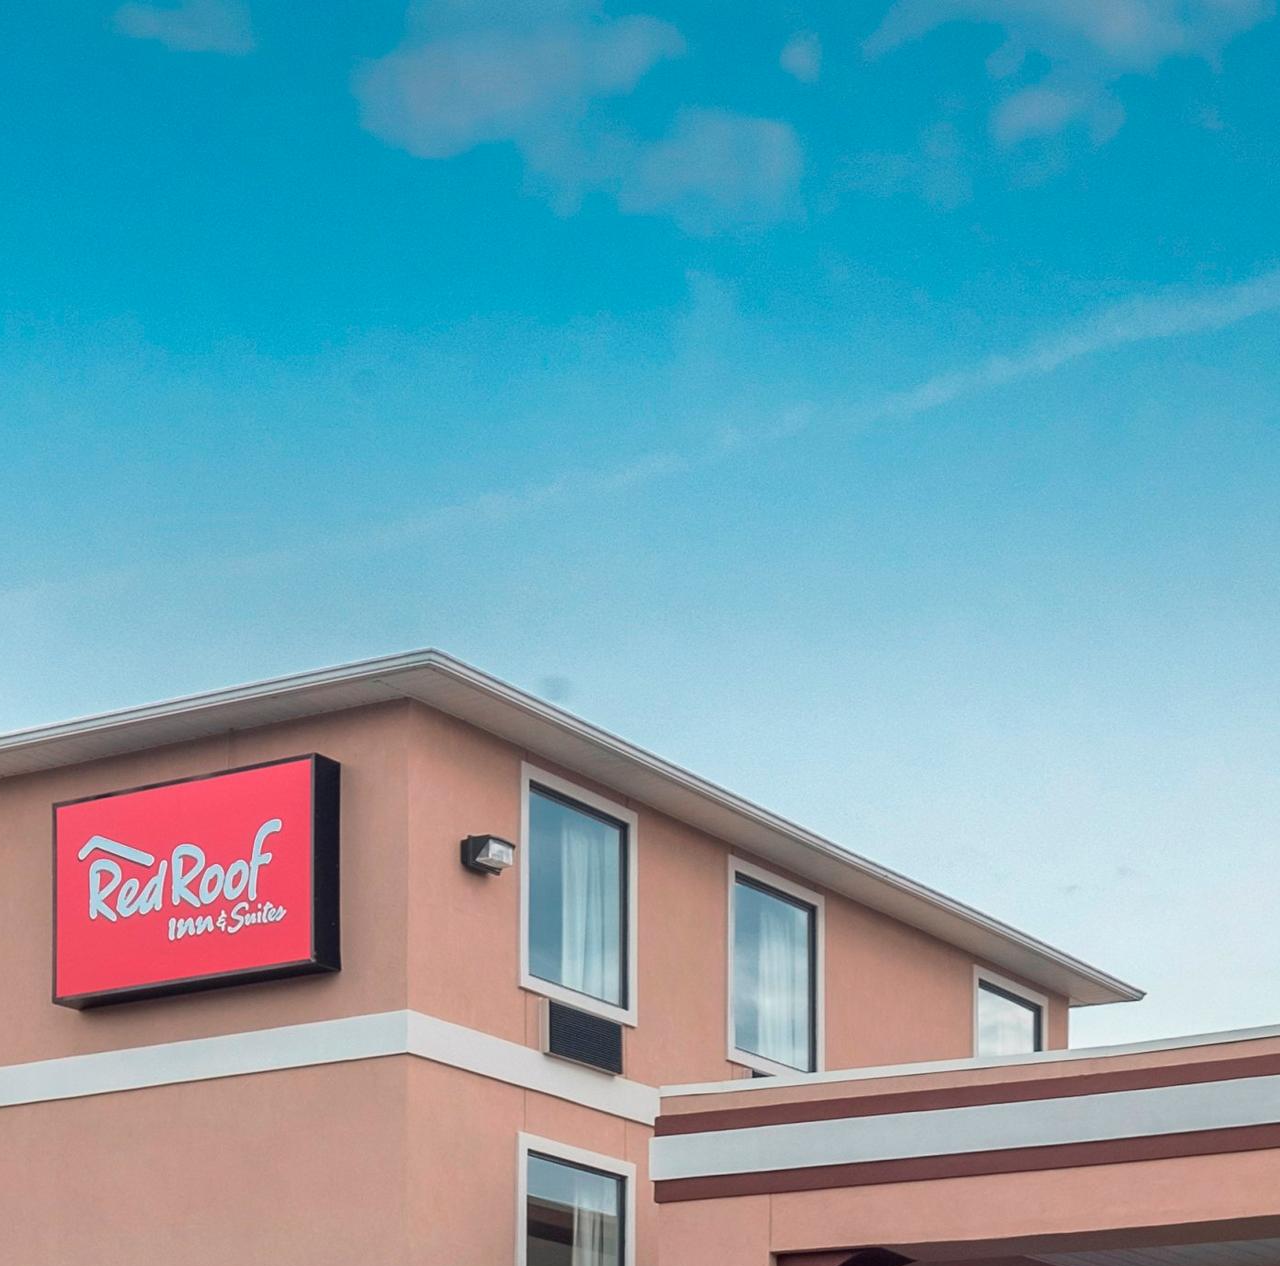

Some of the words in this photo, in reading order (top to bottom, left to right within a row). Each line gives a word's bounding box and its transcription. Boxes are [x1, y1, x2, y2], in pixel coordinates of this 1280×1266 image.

[88, 859, 168, 922] Red
[171, 818, 283, 907] Roof
[168, 915, 215, 941] Inn
[216, 909, 227, 932] &
[227, 901, 287, 933] Suites
